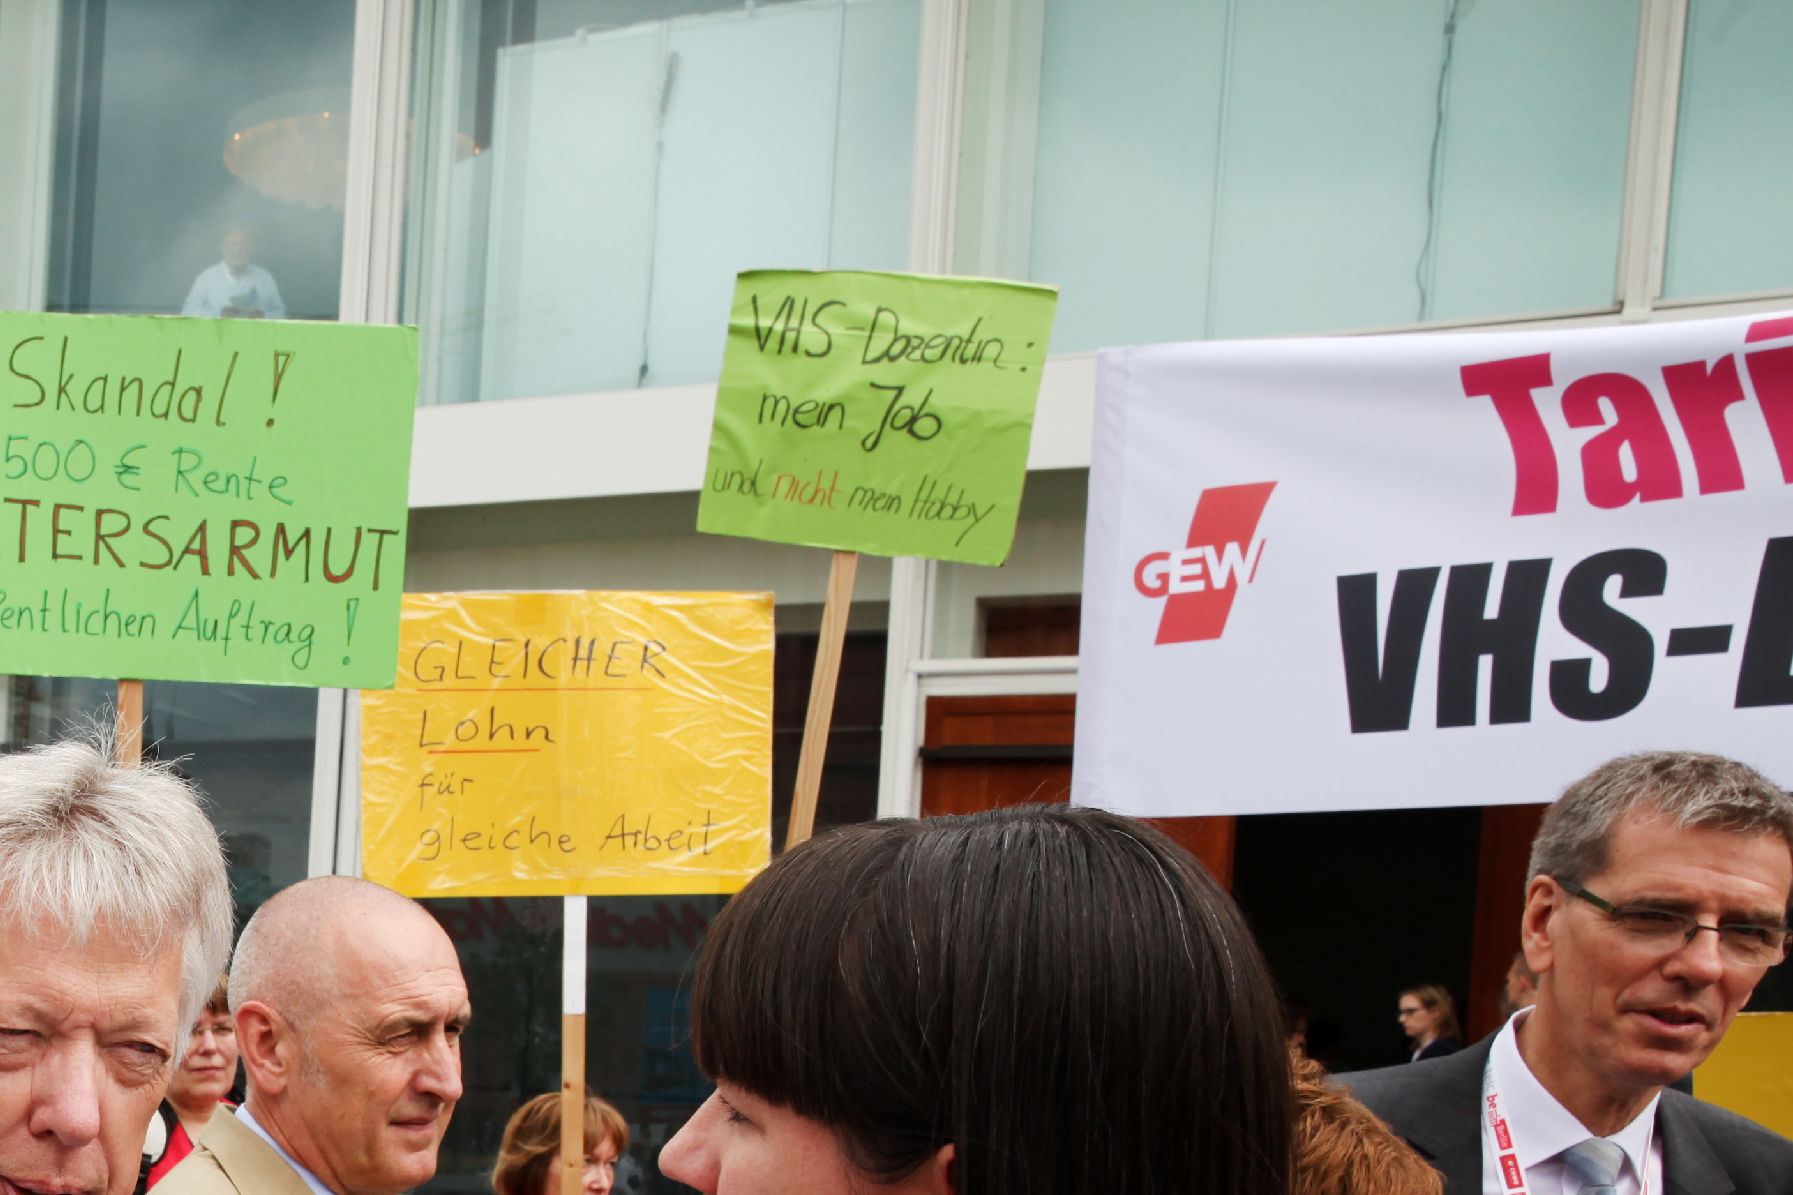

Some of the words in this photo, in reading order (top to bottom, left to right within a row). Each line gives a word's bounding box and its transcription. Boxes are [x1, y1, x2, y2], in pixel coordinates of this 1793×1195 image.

[757, 391, 846, 431] mein
[860, 381, 943, 454] Job
[4, 434, 98, 484] 500
[113, 443, 149, 492] €
[171, 445, 295, 506] Rente
[711, 457, 764, 499] und
[770, 468, 844, 509] nicht
[846, 484, 903, 516] mein
[907, 473, 997, 549] Hobby
[1133, 538, 1266, 600] GEW
[171, 585, 316, 671] Auftrag
[412, 635, 670, 684] GLEICHER
[417, 705, 557, 750] Lohn
[416, 771, 475, 811] für
[416, 815, 578, 863] gleiche
[598, 808, 720, 858] Arbeit
